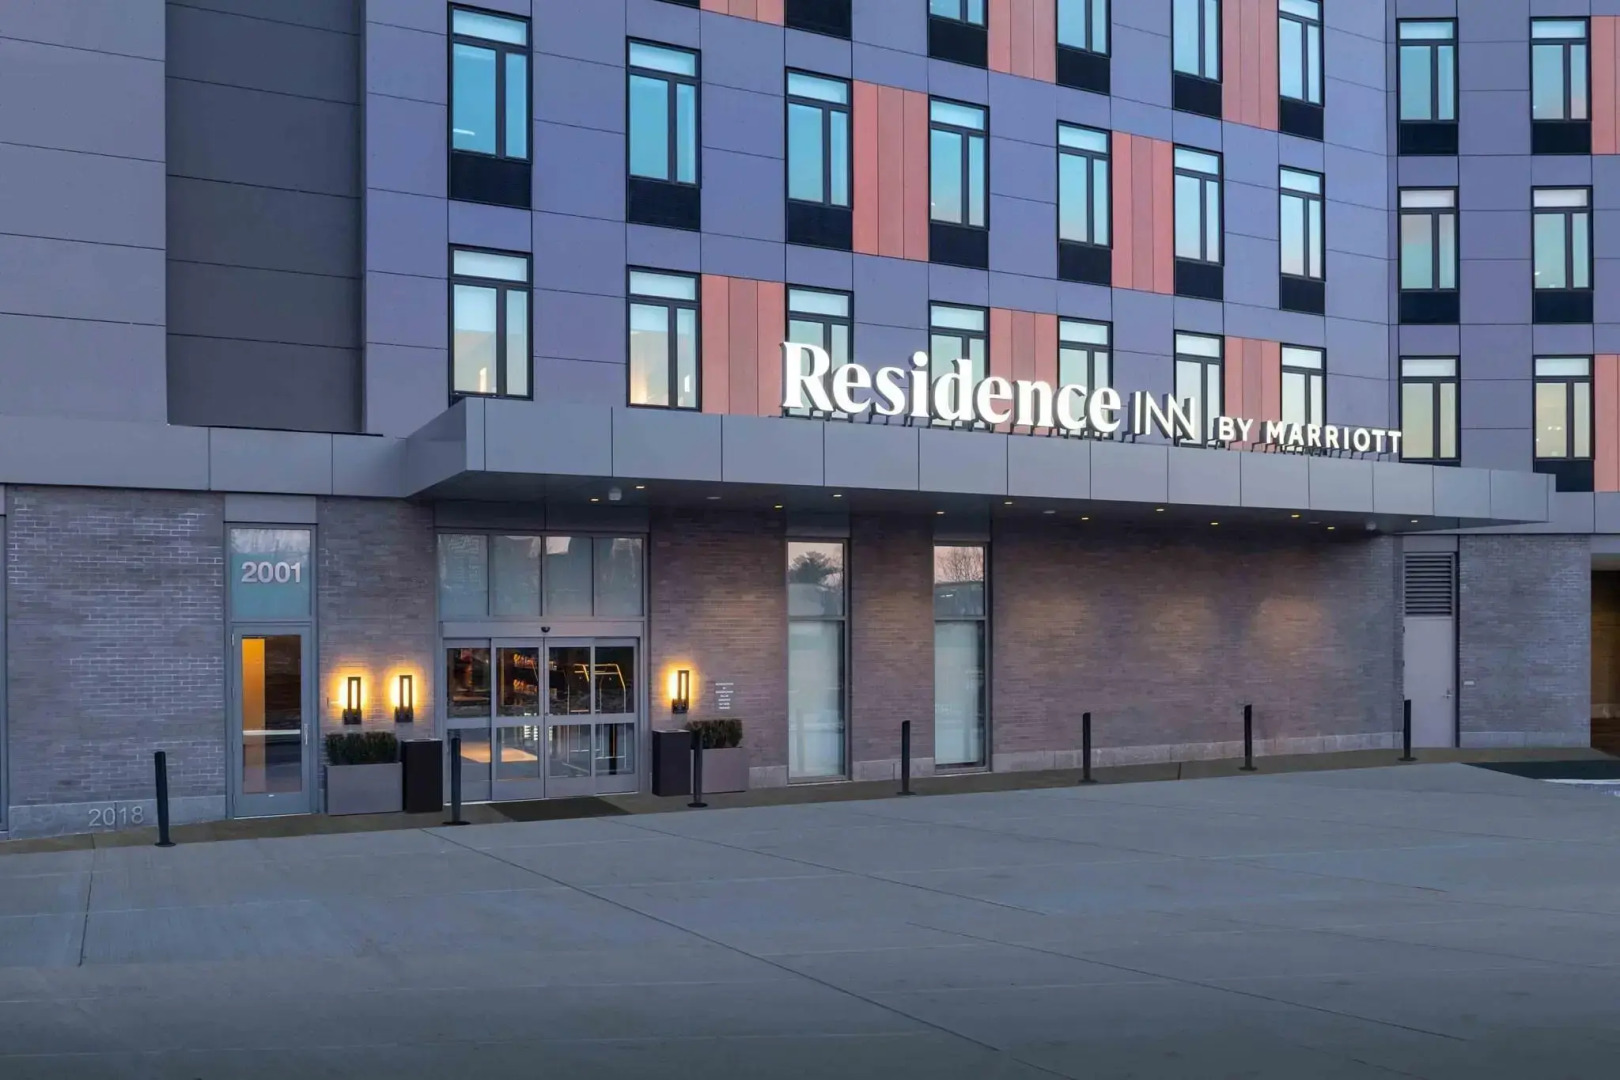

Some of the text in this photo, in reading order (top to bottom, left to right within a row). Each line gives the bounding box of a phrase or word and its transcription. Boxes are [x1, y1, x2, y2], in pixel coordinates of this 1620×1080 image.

[783, 341, 1402, 453] Residence INN BY MARRIOTT
[241, 561, 301, 583] 2001
[88, 806, 144, 827] 2018
